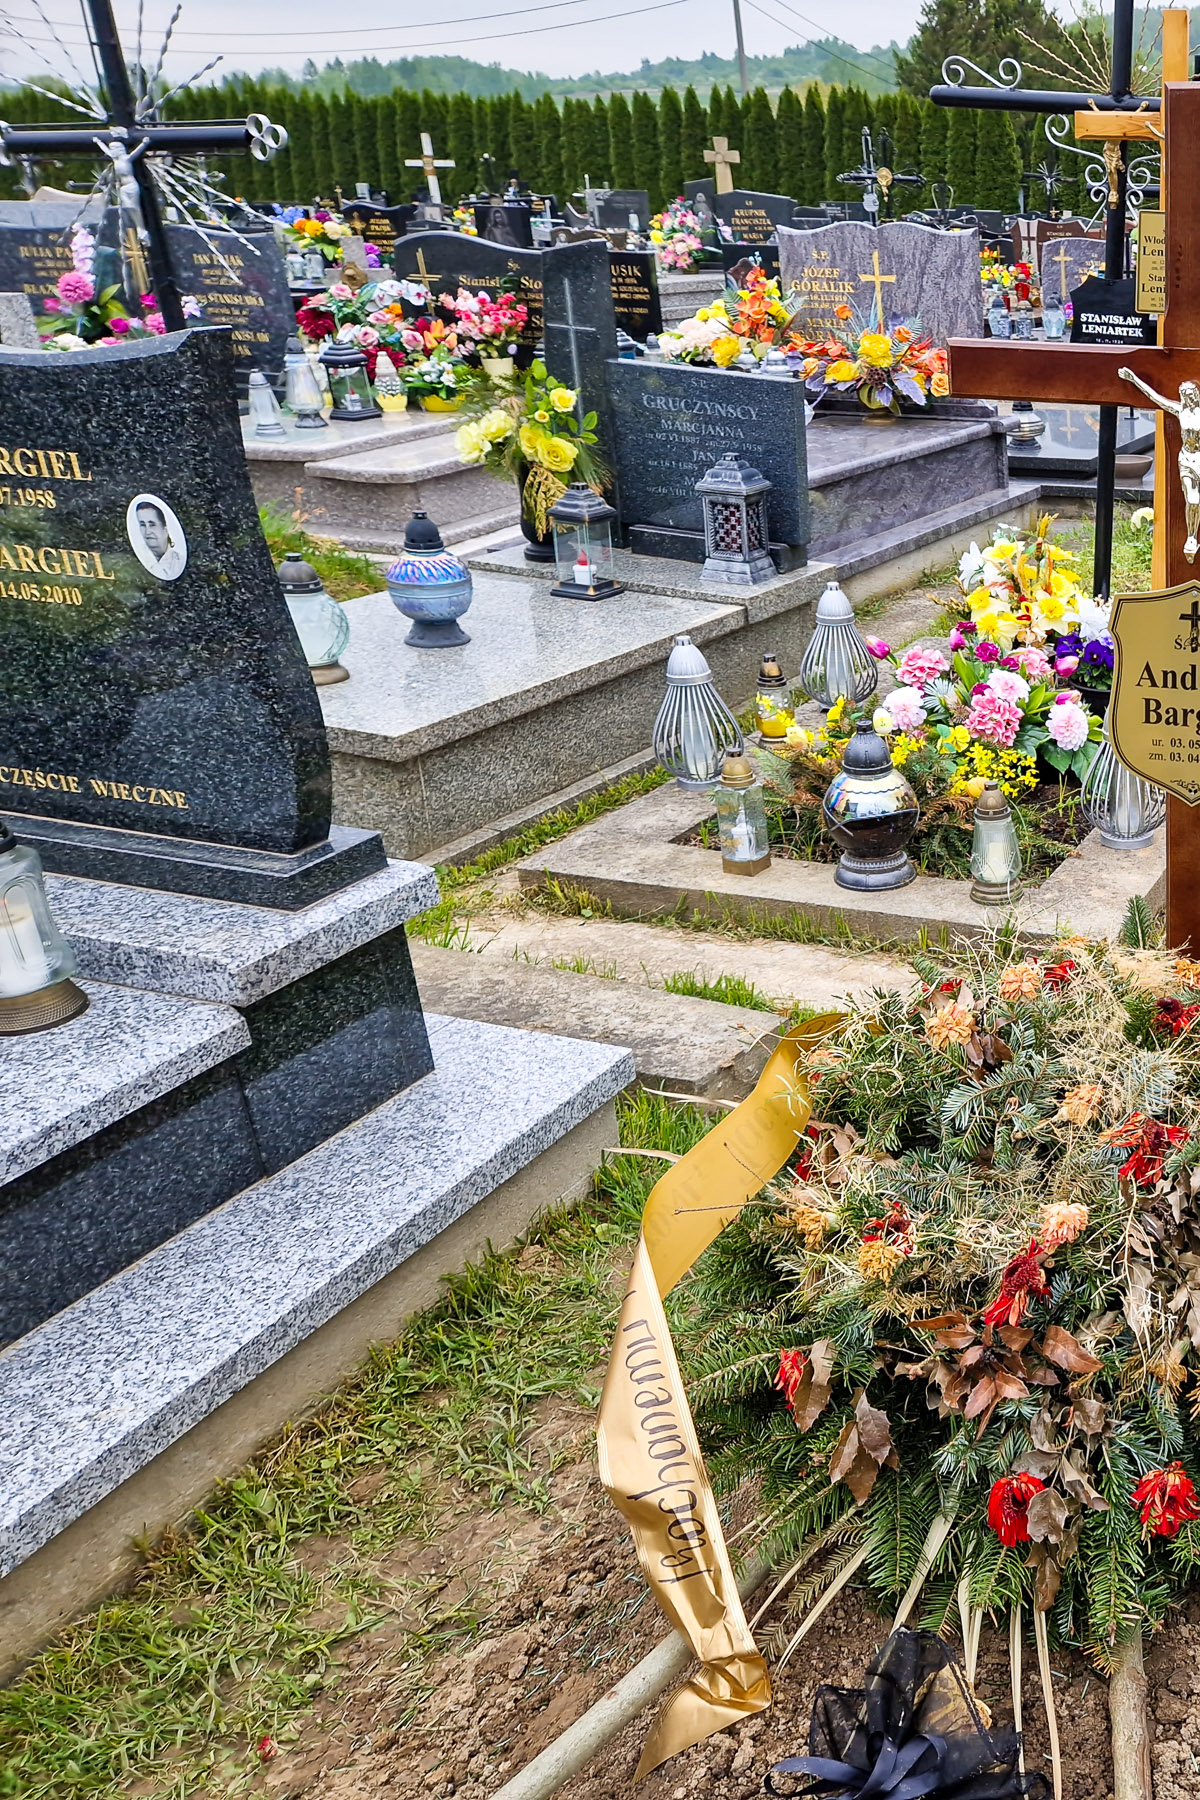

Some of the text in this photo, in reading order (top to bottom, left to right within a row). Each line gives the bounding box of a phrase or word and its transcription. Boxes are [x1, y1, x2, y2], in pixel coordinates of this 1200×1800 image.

[801, 266, 840, 278] JÓZEF
[791, 278, 855, 294] GÓRALIK
[1080, 313, 1143, 326] STANISŁAW
[1081, 324, 1144, 338] LENIARTEK
[692, 449, 716, 462] JAN
[0, 486, 57, 509] 7.1958
[1152, 738, 1164, 747] ur.
[1170, 738, 1185, 749] 03.
[1148, 752, 1166, 762] zm.
[1169, 752, 1185, 763] 03.
[88, 778, 189, 809] WIECZNE
